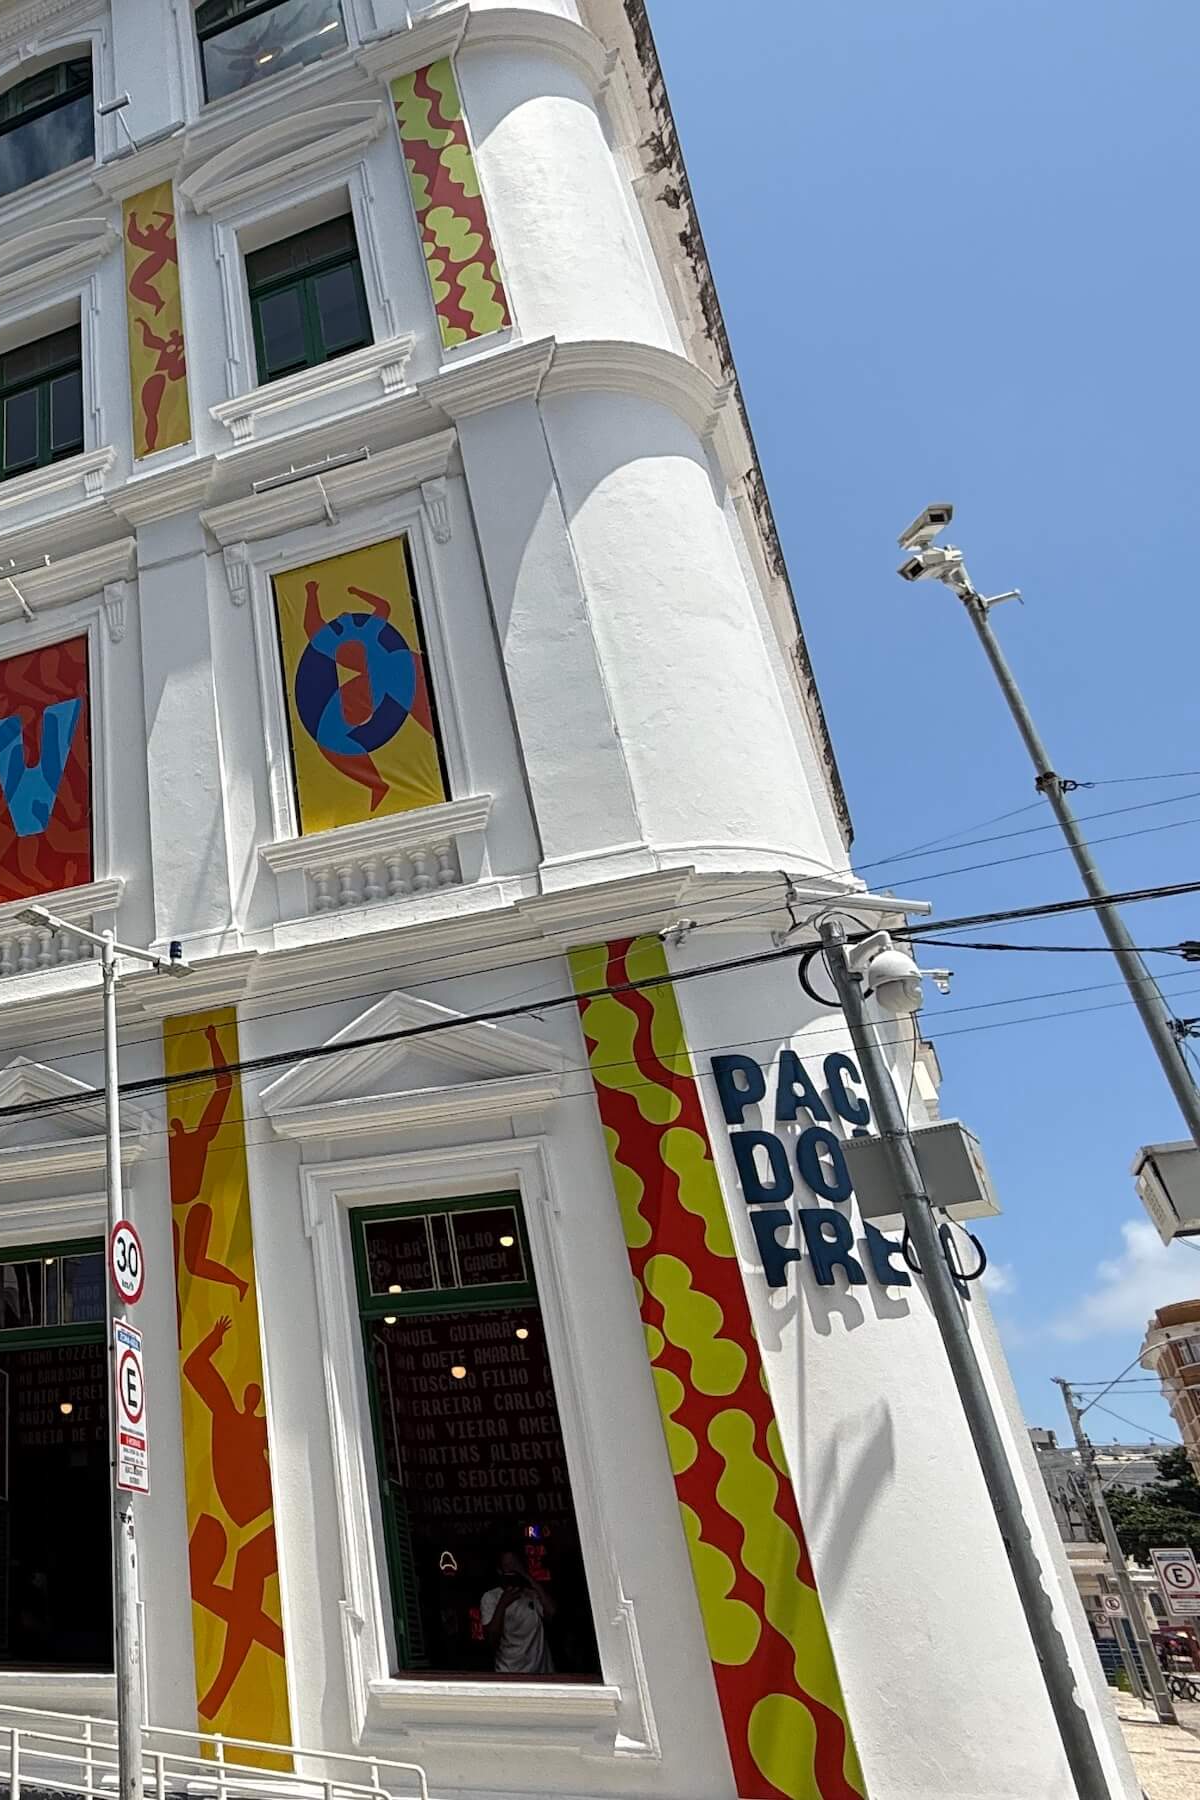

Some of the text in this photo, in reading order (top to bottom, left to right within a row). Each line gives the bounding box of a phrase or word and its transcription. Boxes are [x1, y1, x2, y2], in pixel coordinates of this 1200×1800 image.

[710, 1049, 870, 1137] PAÇ
[729, 1126, 854, 1204] DO
[117, 1236, 138, 1278] 30
[474, 1344, 530, 1366] AMARAL
[127, 1367, 138, 1409] E
[482, 1368, 530, 1388] FILHO
[445, 1418, 510, 1440] VIEIRA
[1172, 1568, 1187, 1584] E
